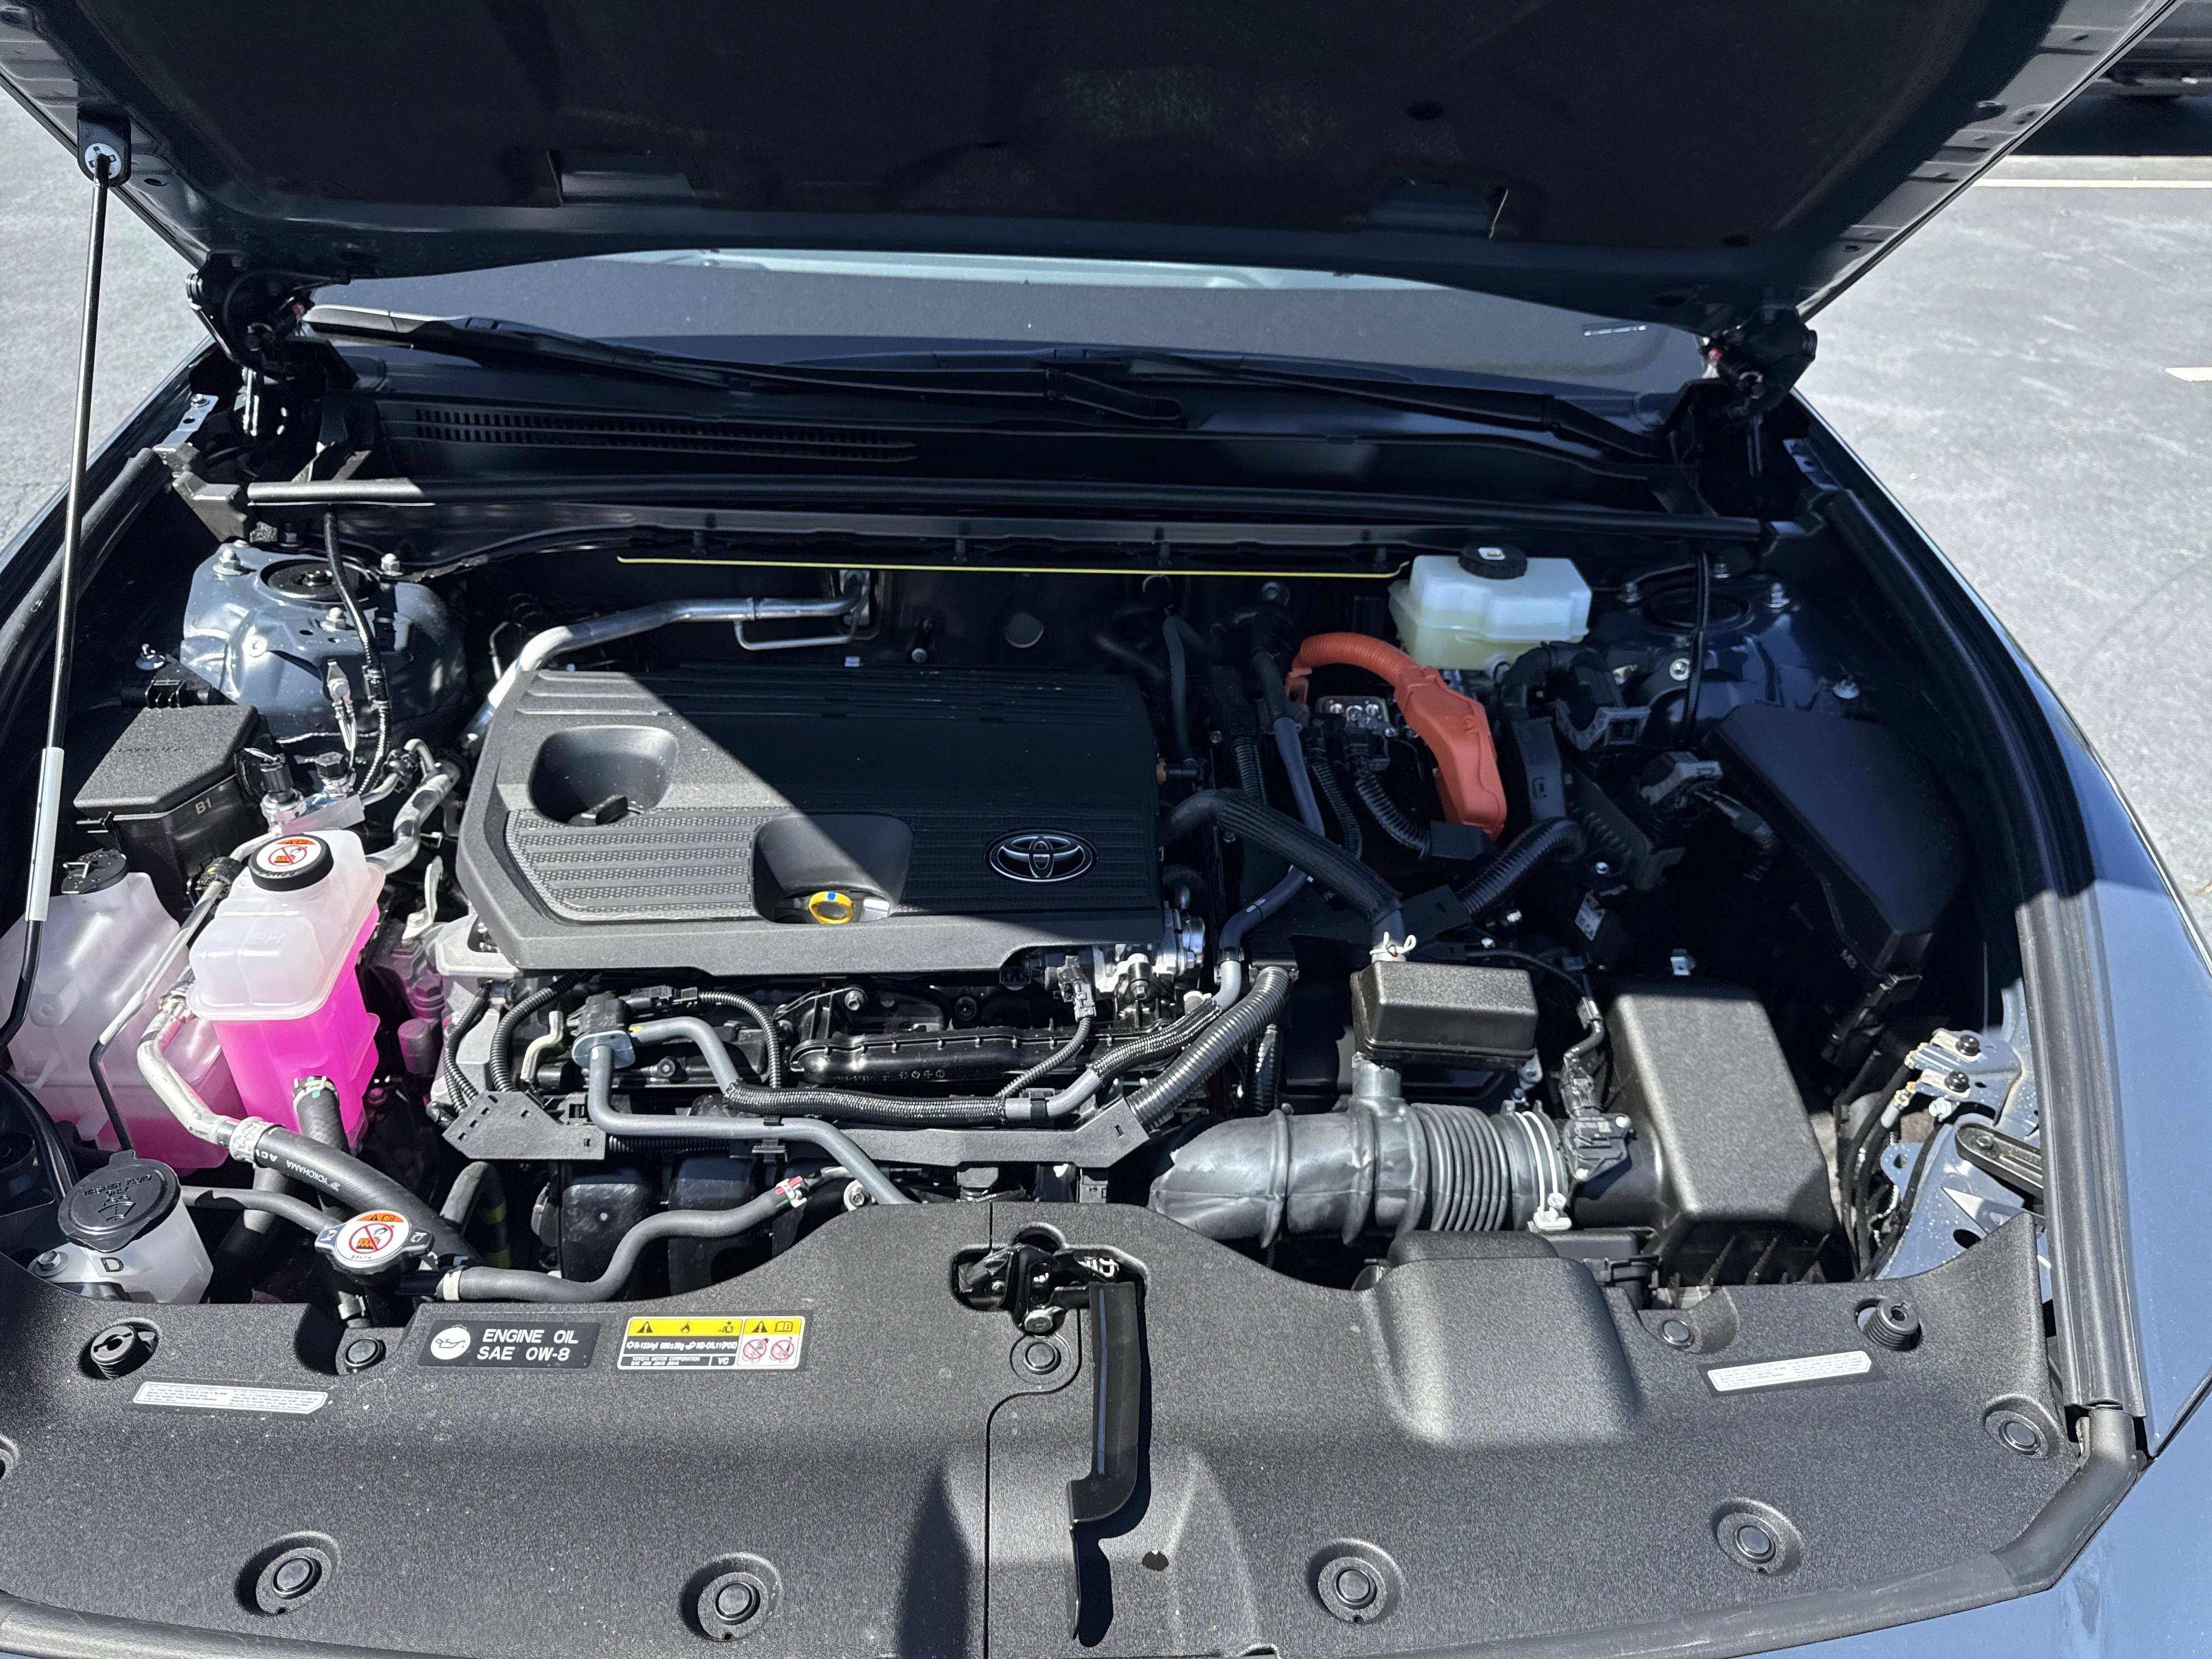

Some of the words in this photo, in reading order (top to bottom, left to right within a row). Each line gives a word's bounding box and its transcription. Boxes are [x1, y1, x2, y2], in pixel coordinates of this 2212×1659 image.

[195, 797, 212, 815] B1
[286, 1159, 328, 1186] YOKOHAMA
[100, 1257, 124, 1272] D
[482, 1329, 545, 1343] ENGINE
[553, 1330, 579, 1344] OIL
[477, 1346, 515, 1360] SAE
